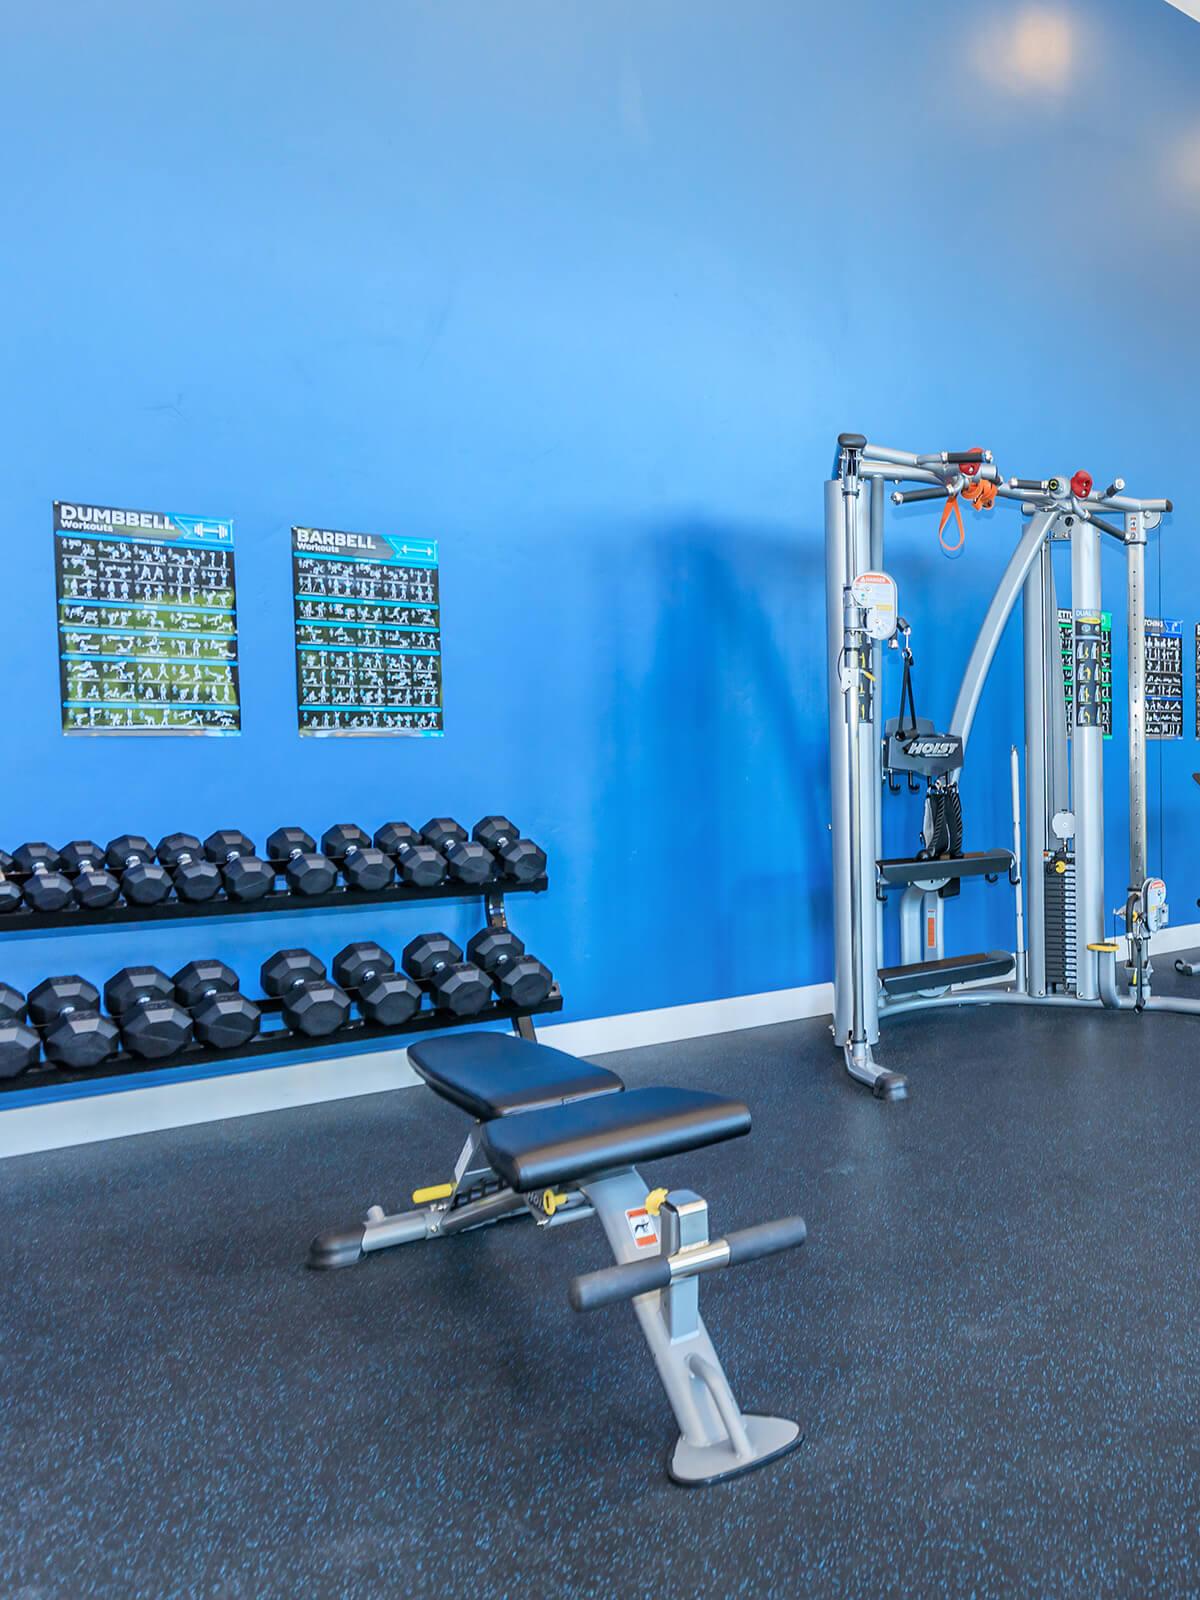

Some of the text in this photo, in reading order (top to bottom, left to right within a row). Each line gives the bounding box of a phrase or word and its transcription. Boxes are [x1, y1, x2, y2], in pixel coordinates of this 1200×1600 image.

[60, 504, 176, 531] DUMBBELL
[60, 519, 114, 533] Workouts
[296, 529, 377, 550] BARBELL
[296, 542, 340, 553] Workouts
[907, 742, 959, 755] HOIST
